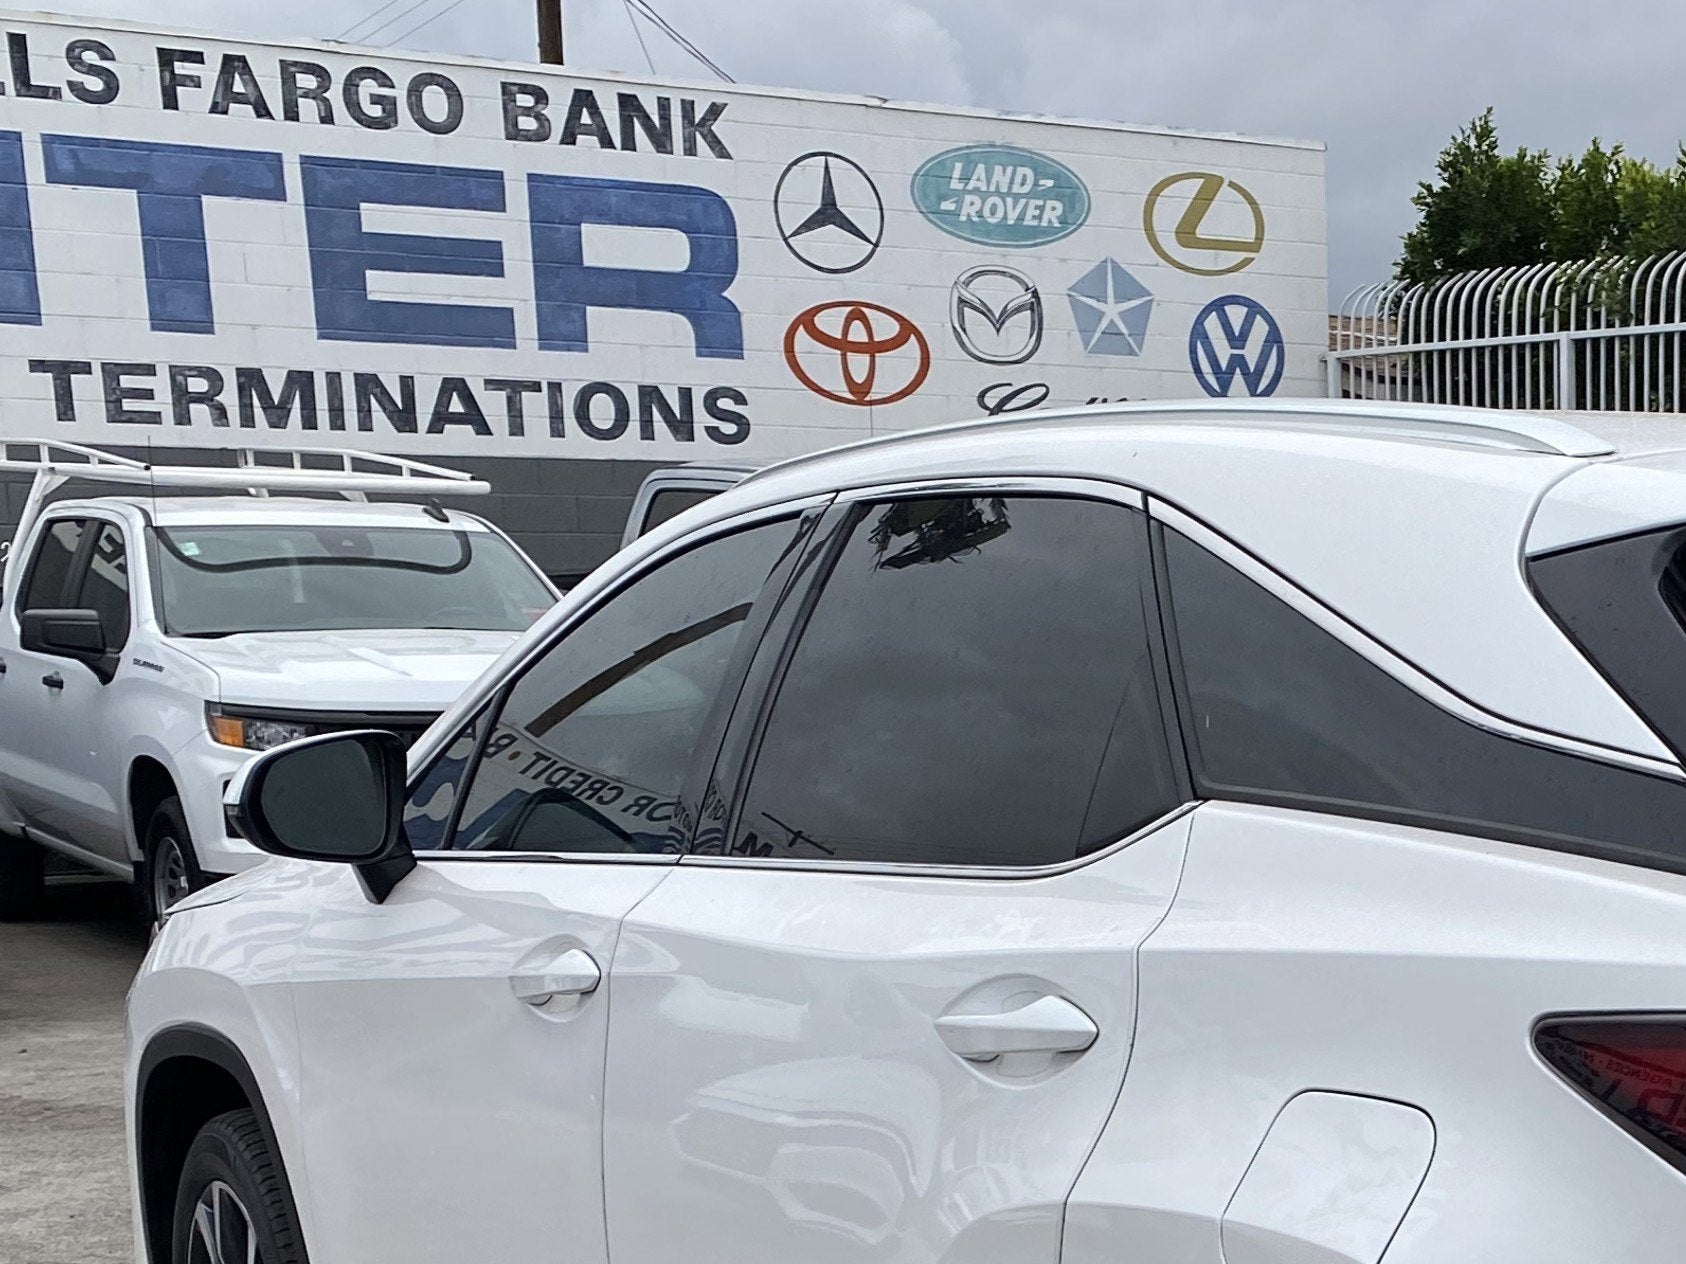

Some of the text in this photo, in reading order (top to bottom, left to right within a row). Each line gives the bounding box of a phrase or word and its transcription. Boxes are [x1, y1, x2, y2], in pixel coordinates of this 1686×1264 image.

[0, 31, 733, 160] LS FARGO BANK
[28, 358, 751, 446] TERMINATIONS
